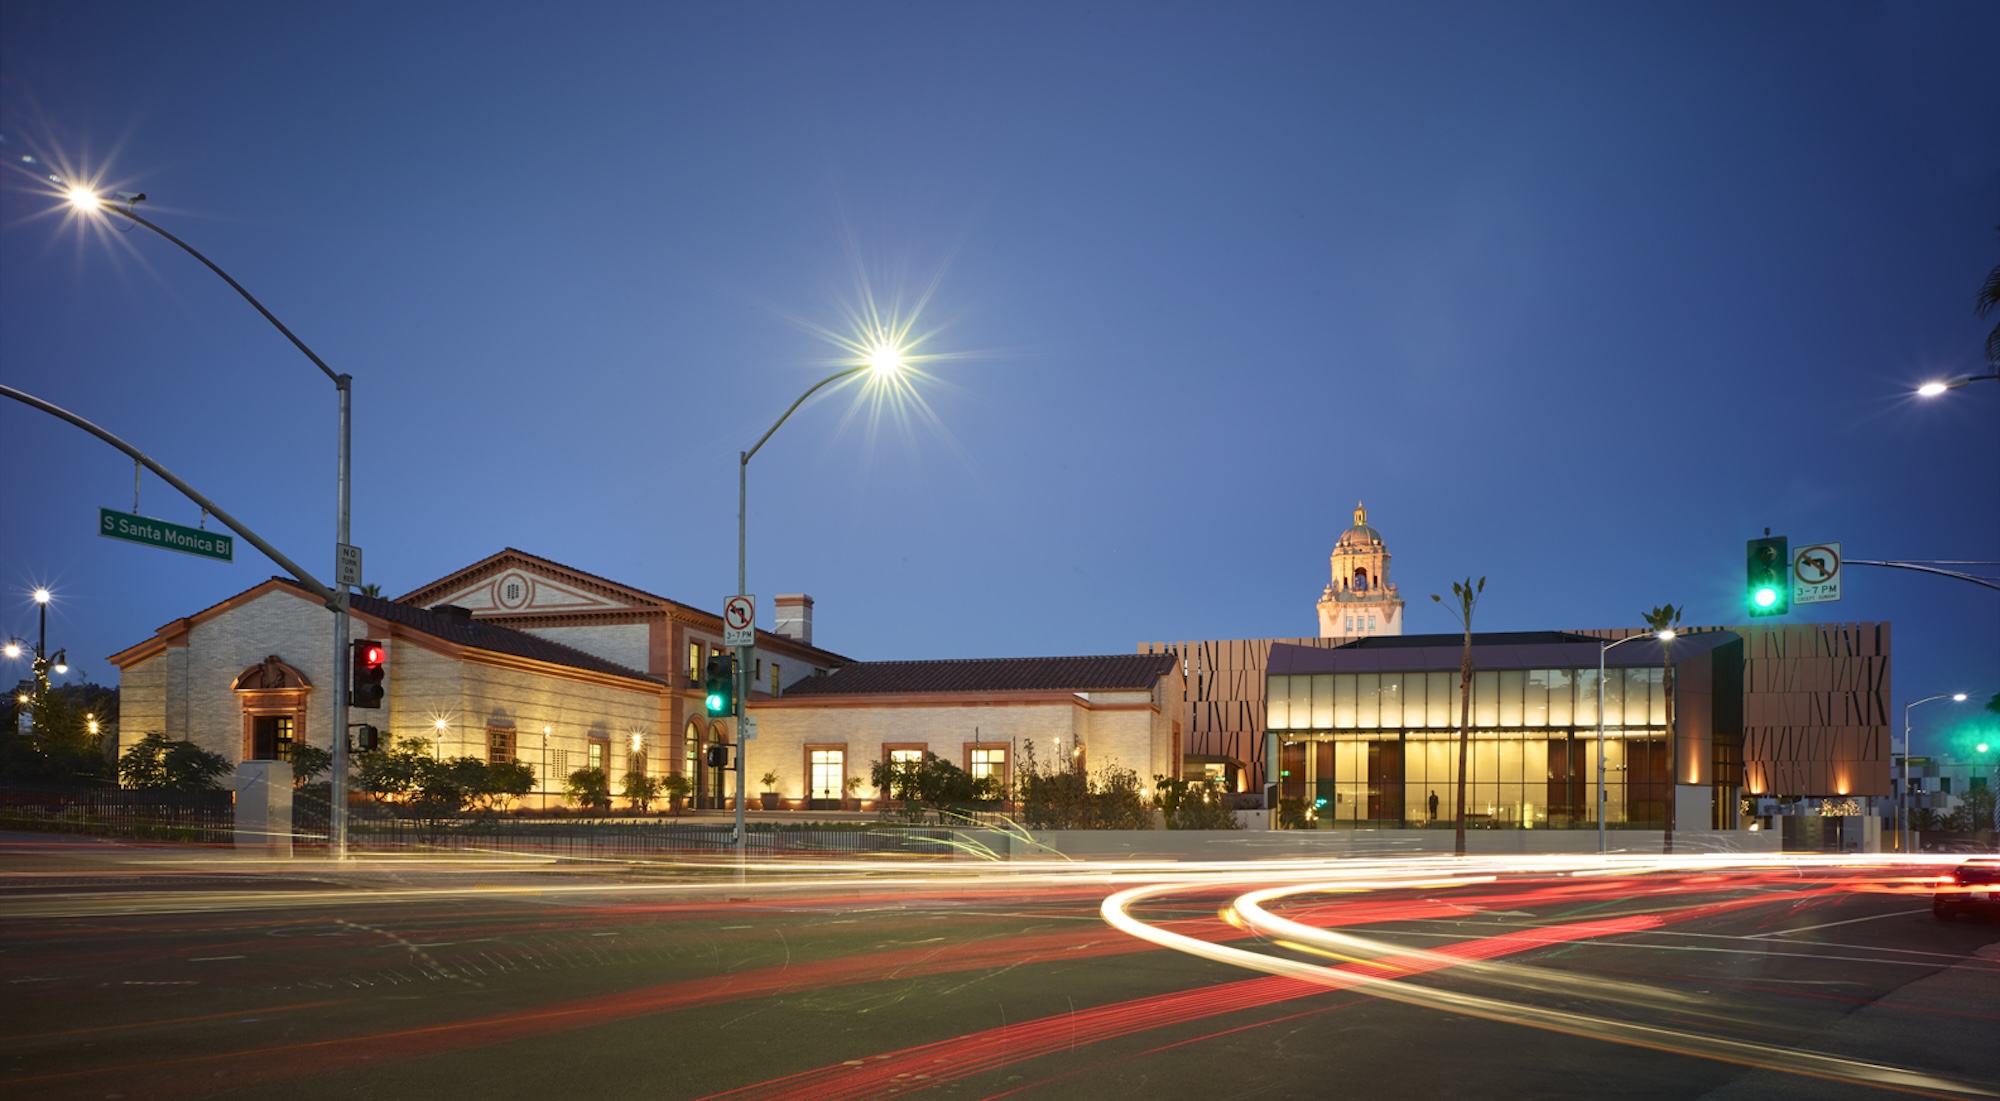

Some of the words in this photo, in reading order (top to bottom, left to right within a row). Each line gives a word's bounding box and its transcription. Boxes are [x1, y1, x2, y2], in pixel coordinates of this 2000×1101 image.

[104, 515, 115, 530] S
[119, 518, 162, 540] Santa
[164, 528, 213, 551] Monica
[215, 540, 230, 555] Bl
[343, 548, 356, 558] NO
[341, 557, 357, 566] TURN
[344, 566, 354, 574] ON
[343, 575, 356, 583] RED
[1797, 586, 1819, 596] 3-7
[1821, 584, 1837, 594] PM
[741, 630, 752, 638] PM
